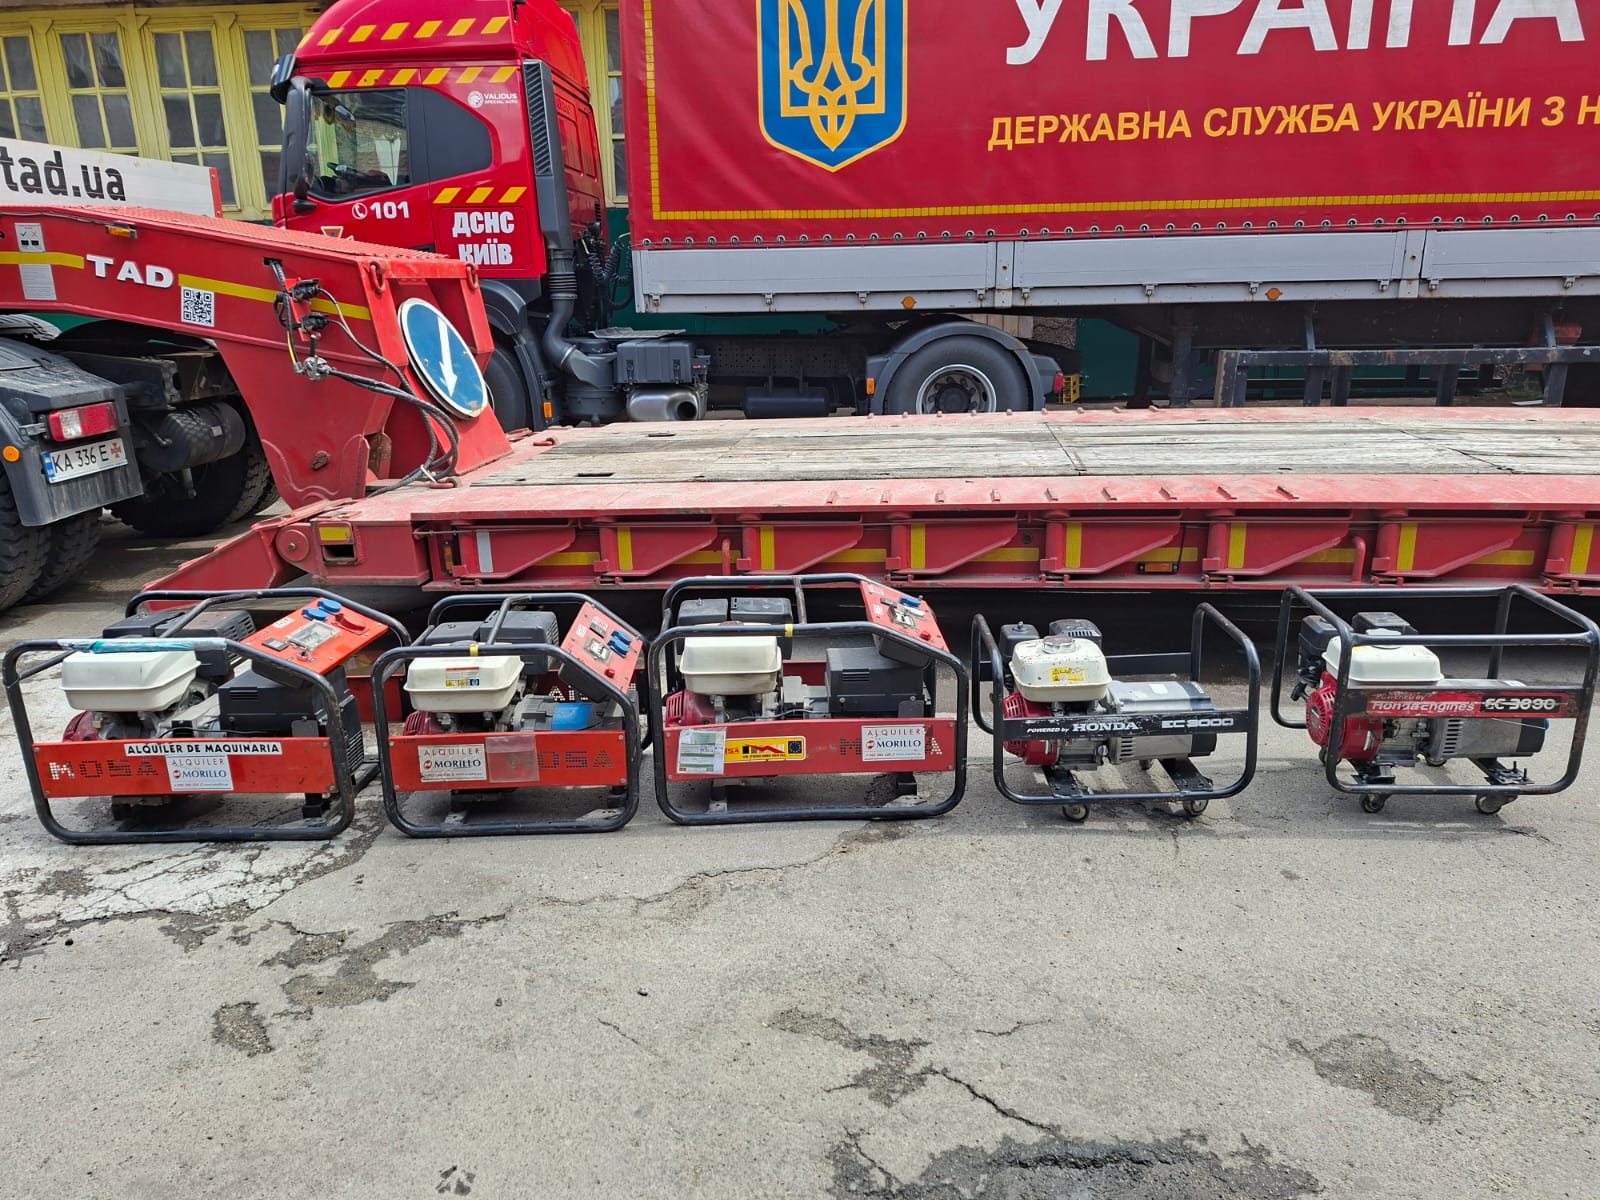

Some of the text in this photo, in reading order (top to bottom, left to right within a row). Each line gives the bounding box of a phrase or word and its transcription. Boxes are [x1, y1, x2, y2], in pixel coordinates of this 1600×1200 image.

[988, 109, 1192, 152] ДЕРЖАВНА
[1203, 102, 1360, 137] СЛУЖБА
[1372, 91, 1531, 132] УКРАЇНИ
[1541, 96, 1566, 127] З
[0, 146, 126, 201] tad.ua
[370, 201, 410, 219] 101
[452, 211, 515, 238] ДСНС
[458, 238, 513, 265] КИЇВ
[86, 253, 174, 289] TAD
[75, 447, 97, 467] 336
[868, 728, 921, 737] ALQUILER
[1061, 727, 1070, 735] by
[1071, 722, 1139, 732] HONDA
[1161, 720, 1185, 729] EC
[1187, 718, 1234, 728] 3000
[127, 743, 280, 754] ALQUILER DE MAQUINARIA
[424, 748, 480, 756] ALQUILER
[840, 736, 943, 755] MA
[877, 740, 921, 748] MORILLO
[49, 758, 160, 780] MOSA
[172, 758, 225, 766] ALQUILER
[434, 760, 481, 768] MORILLO
[182, 770, 227, 778] MORILLO
